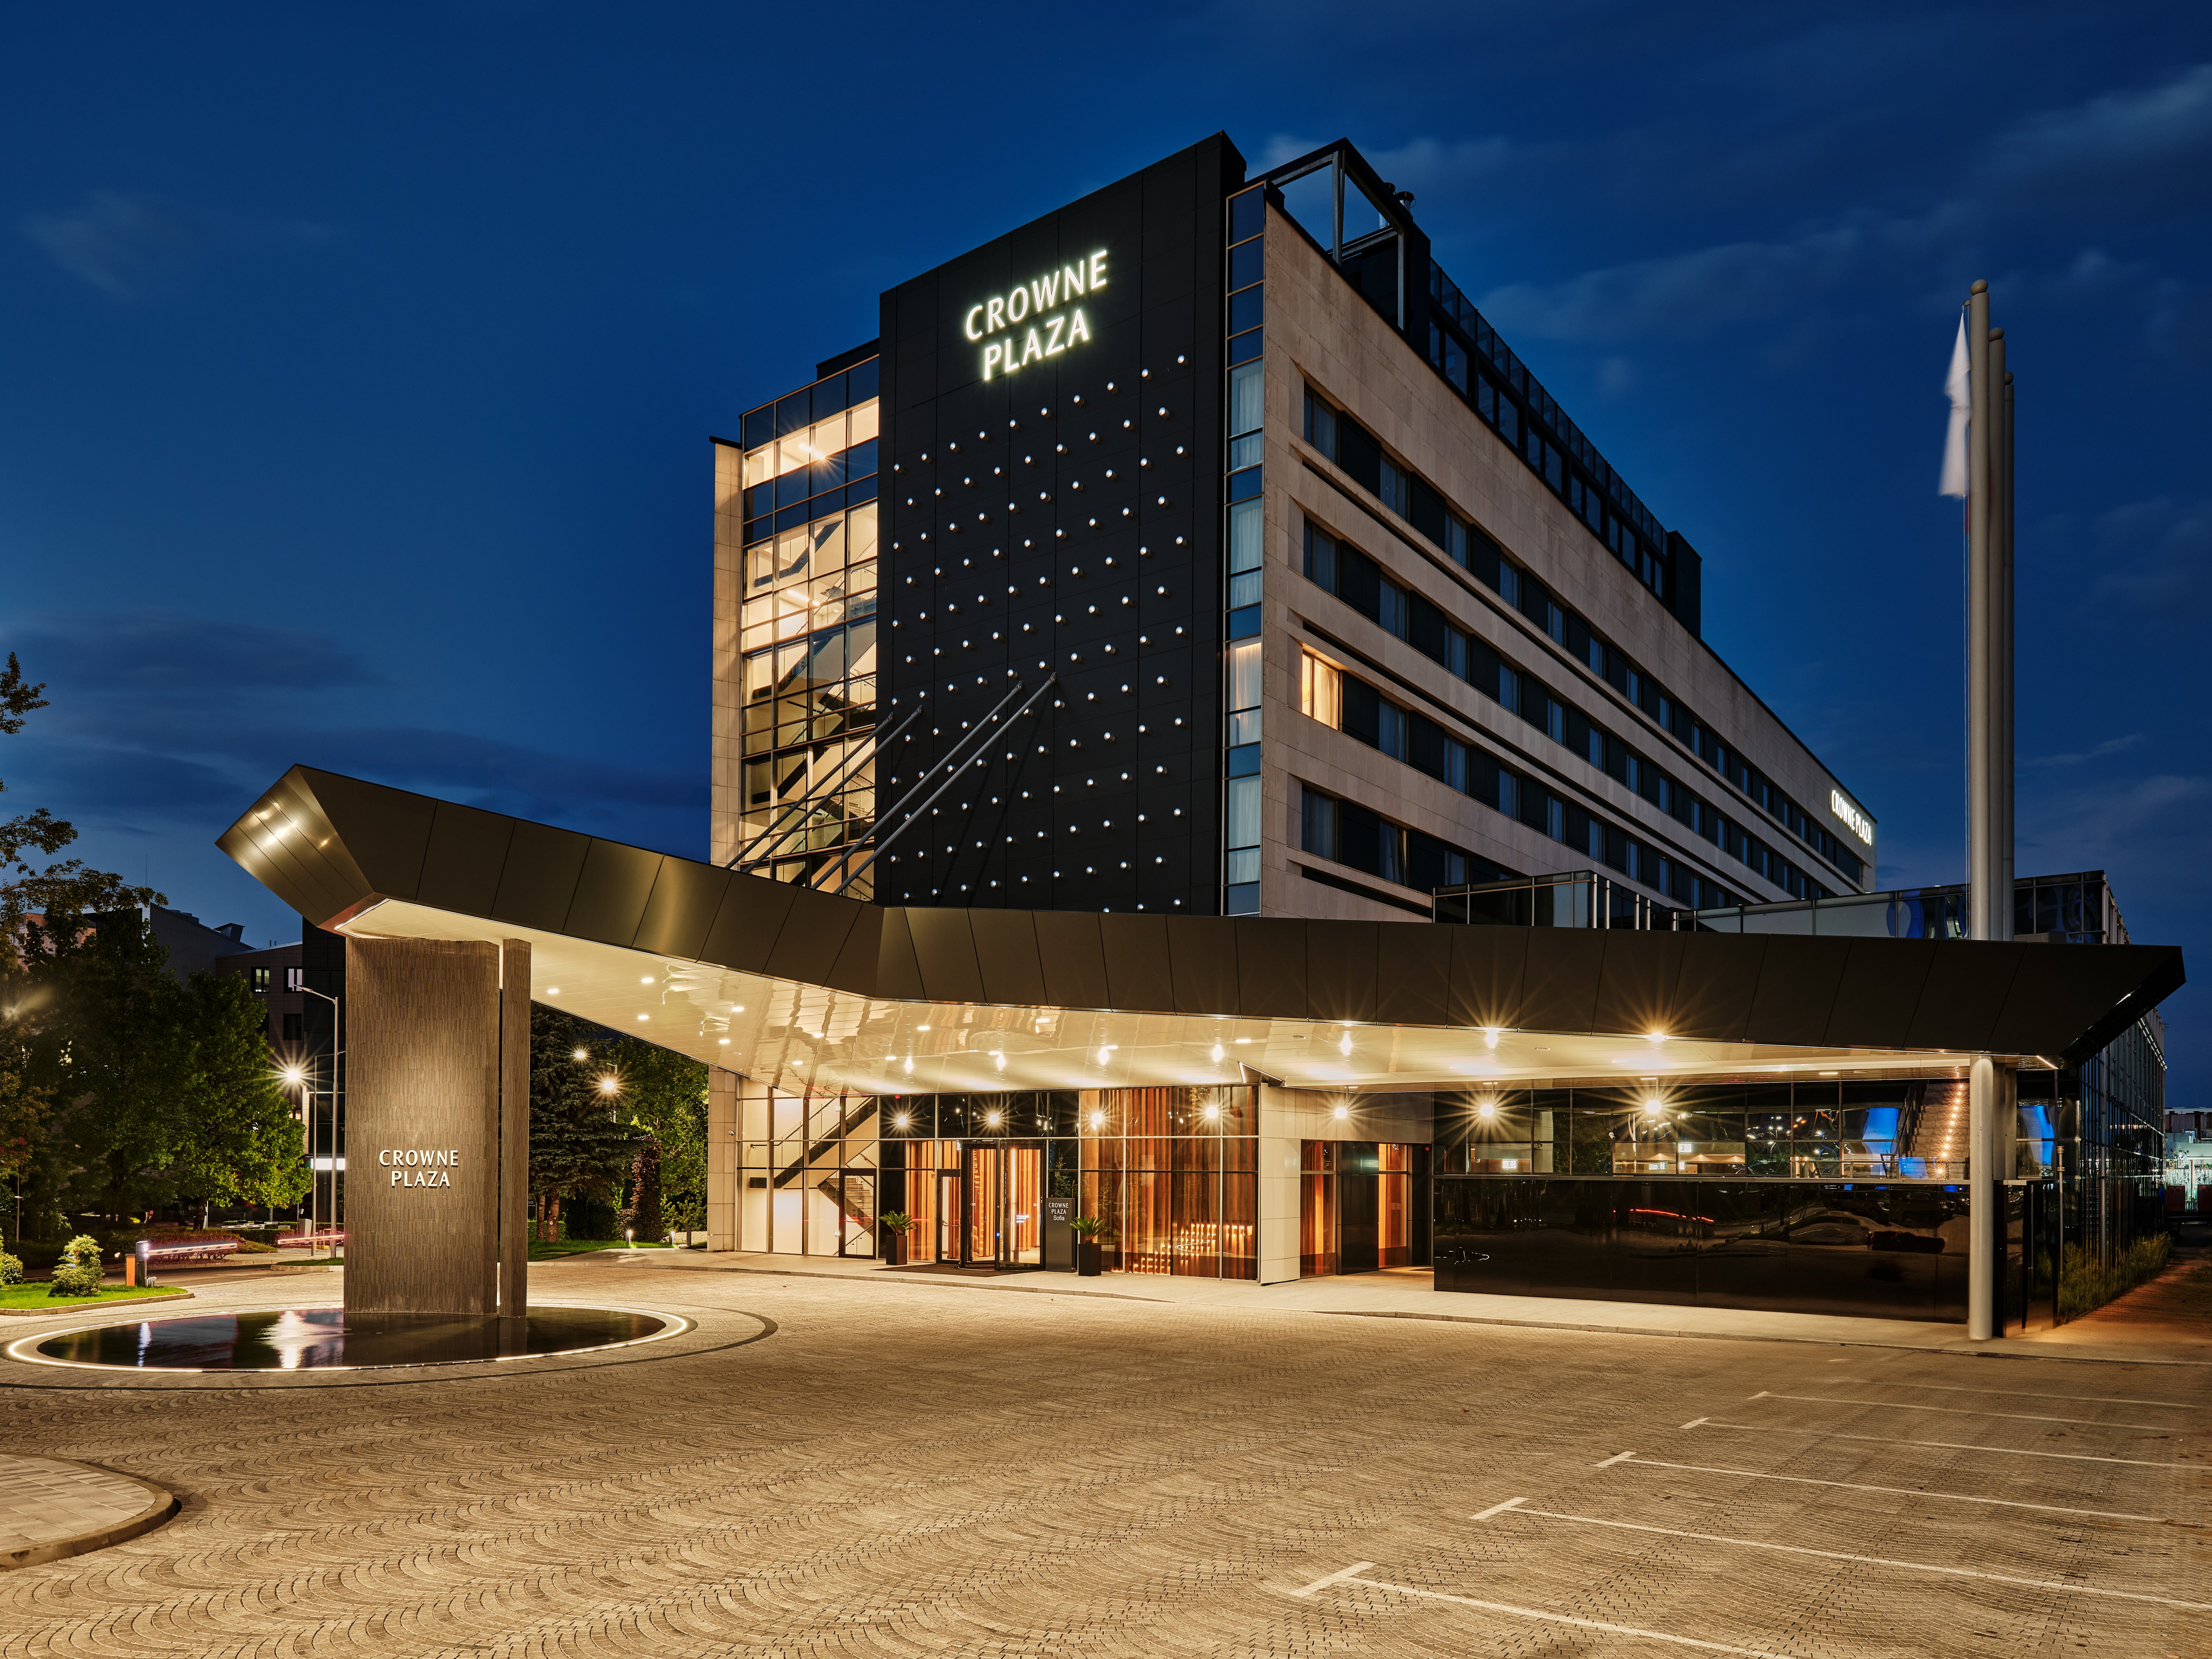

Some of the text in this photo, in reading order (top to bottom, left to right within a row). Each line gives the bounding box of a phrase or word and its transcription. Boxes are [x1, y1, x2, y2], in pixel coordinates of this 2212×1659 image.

[966, 250, 1106, 340] CROWNE
[984, 309, 1089, 380] PLAZA
[1831, 790, 1872, 846] CROWNE PLAZA
[379, 1150, 458, 1166] CROWNE
[391, 1170, 450, 1187] PLAZA
